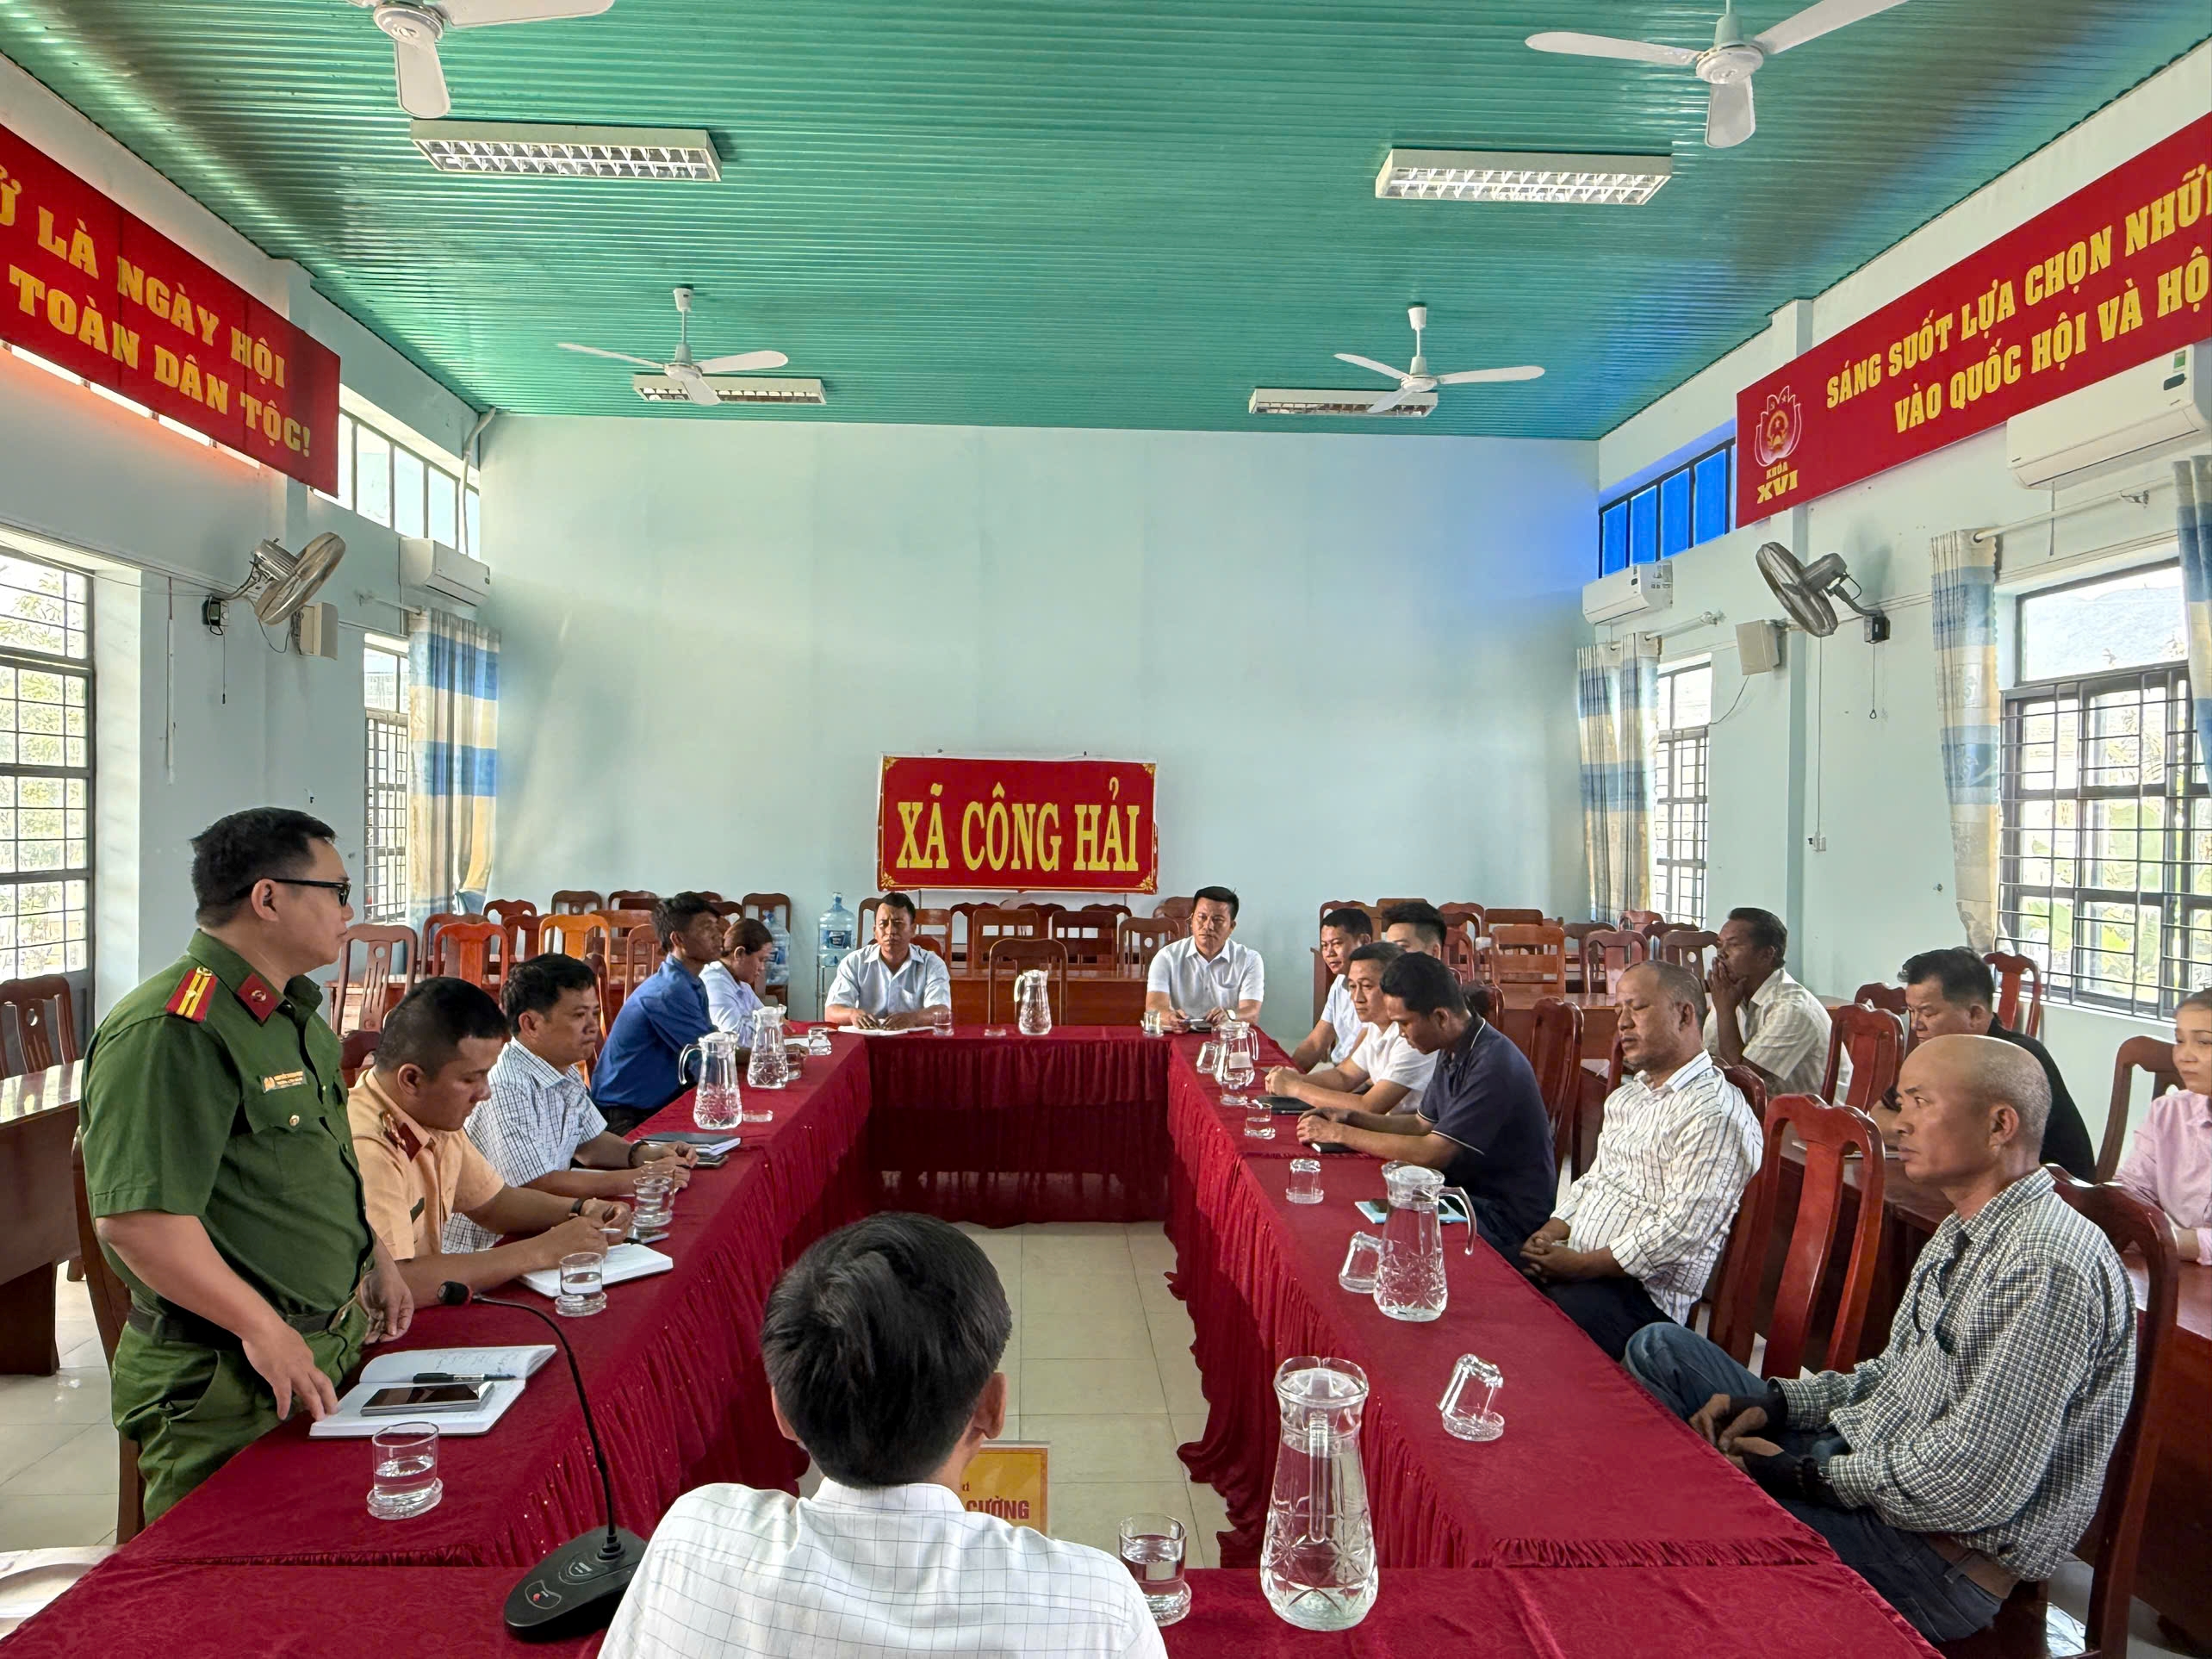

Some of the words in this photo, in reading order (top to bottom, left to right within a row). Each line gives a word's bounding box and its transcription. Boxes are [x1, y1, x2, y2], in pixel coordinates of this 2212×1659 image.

[9, 263, 140, 370] TOÀN
[153, 344, 229, 414] DÂN
[239, 391, 311, 458] TỘC!
[37, 205, 99, 279] LÀ
[117, 255, 220, 346] NGÀY
[230, 326, 285, 388] HỘI
[1825, 351, 1882, 409] SÁNG
[1888, 308, 1954, 377] SUỐT
[1960, 278, 2016, 342] LỰA
[2024, 224, 2113, 307] CHỌN
[1894, 381, 1942, 434] VÀO
[1949, 338, 2022, 410] QUỐC
[2030, 310, 2087, 374] HỘI
[2097, 277, 2144, 343] VÀ
[1756, 469, 1799, 505] XVI
[896, 782, 950, 869] XÃ
[961, 781, 1062, 873] CÔNG
[1072, 776, 1141, 872] HẢI
